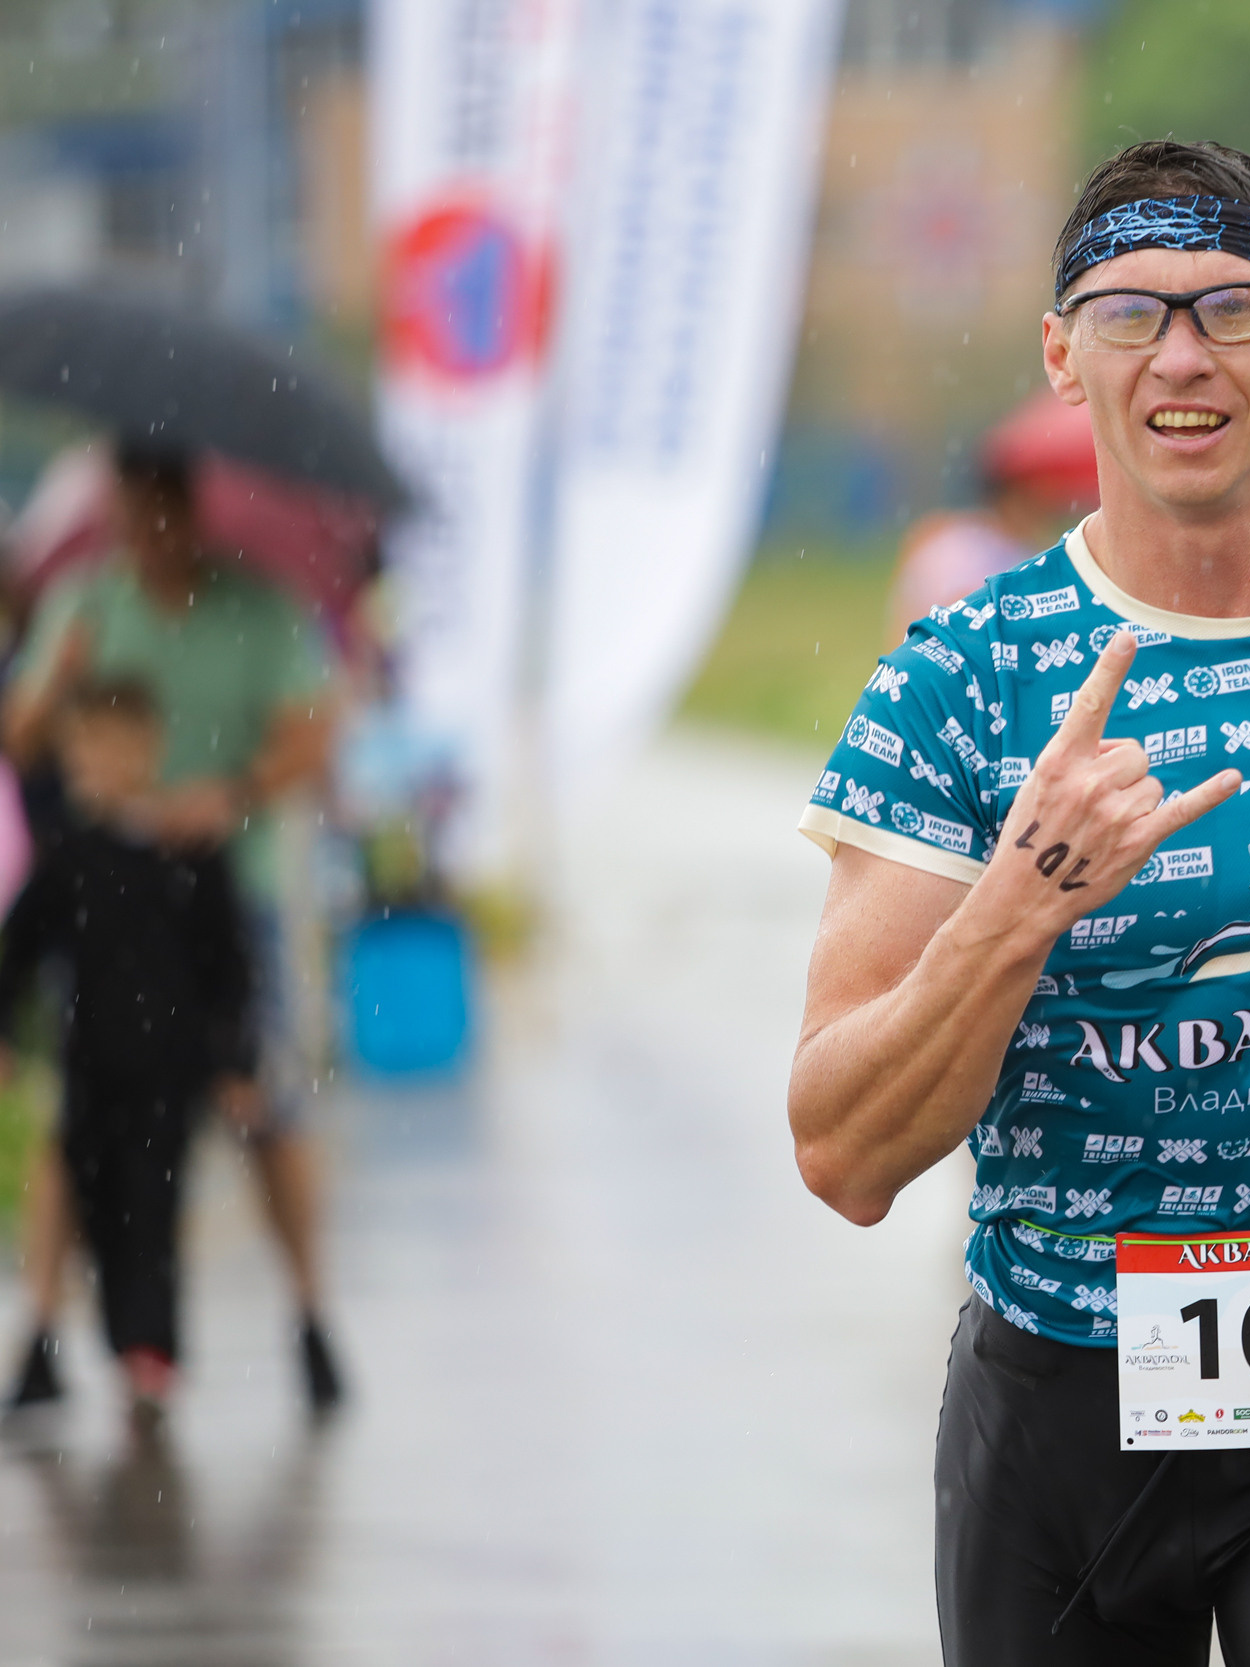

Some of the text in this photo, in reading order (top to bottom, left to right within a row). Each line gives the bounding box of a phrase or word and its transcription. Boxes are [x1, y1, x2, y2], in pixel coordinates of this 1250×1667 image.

[1036, 592, 1069, 606] IRON
[1038, 601, 1076, 614] TEAM
[870, 727, 897, 748] IRON
[869, 740, 898, 763] TEAM
[928, 819, 964, 837] IRON
[928, 832, 968, 851] TEAM
[1167, 852, 1203, 865] IRON
[1169, 864, 1209, 877] TEAM
[1071, 935, 1120, 946] TRIATHL
[1021, 1089, 1066, 1101] TRIATHLON
[1083, 1151, 1141, 1160] TRIATHLON
[1159, 1202, 1218, 1212] TRIATHLON
